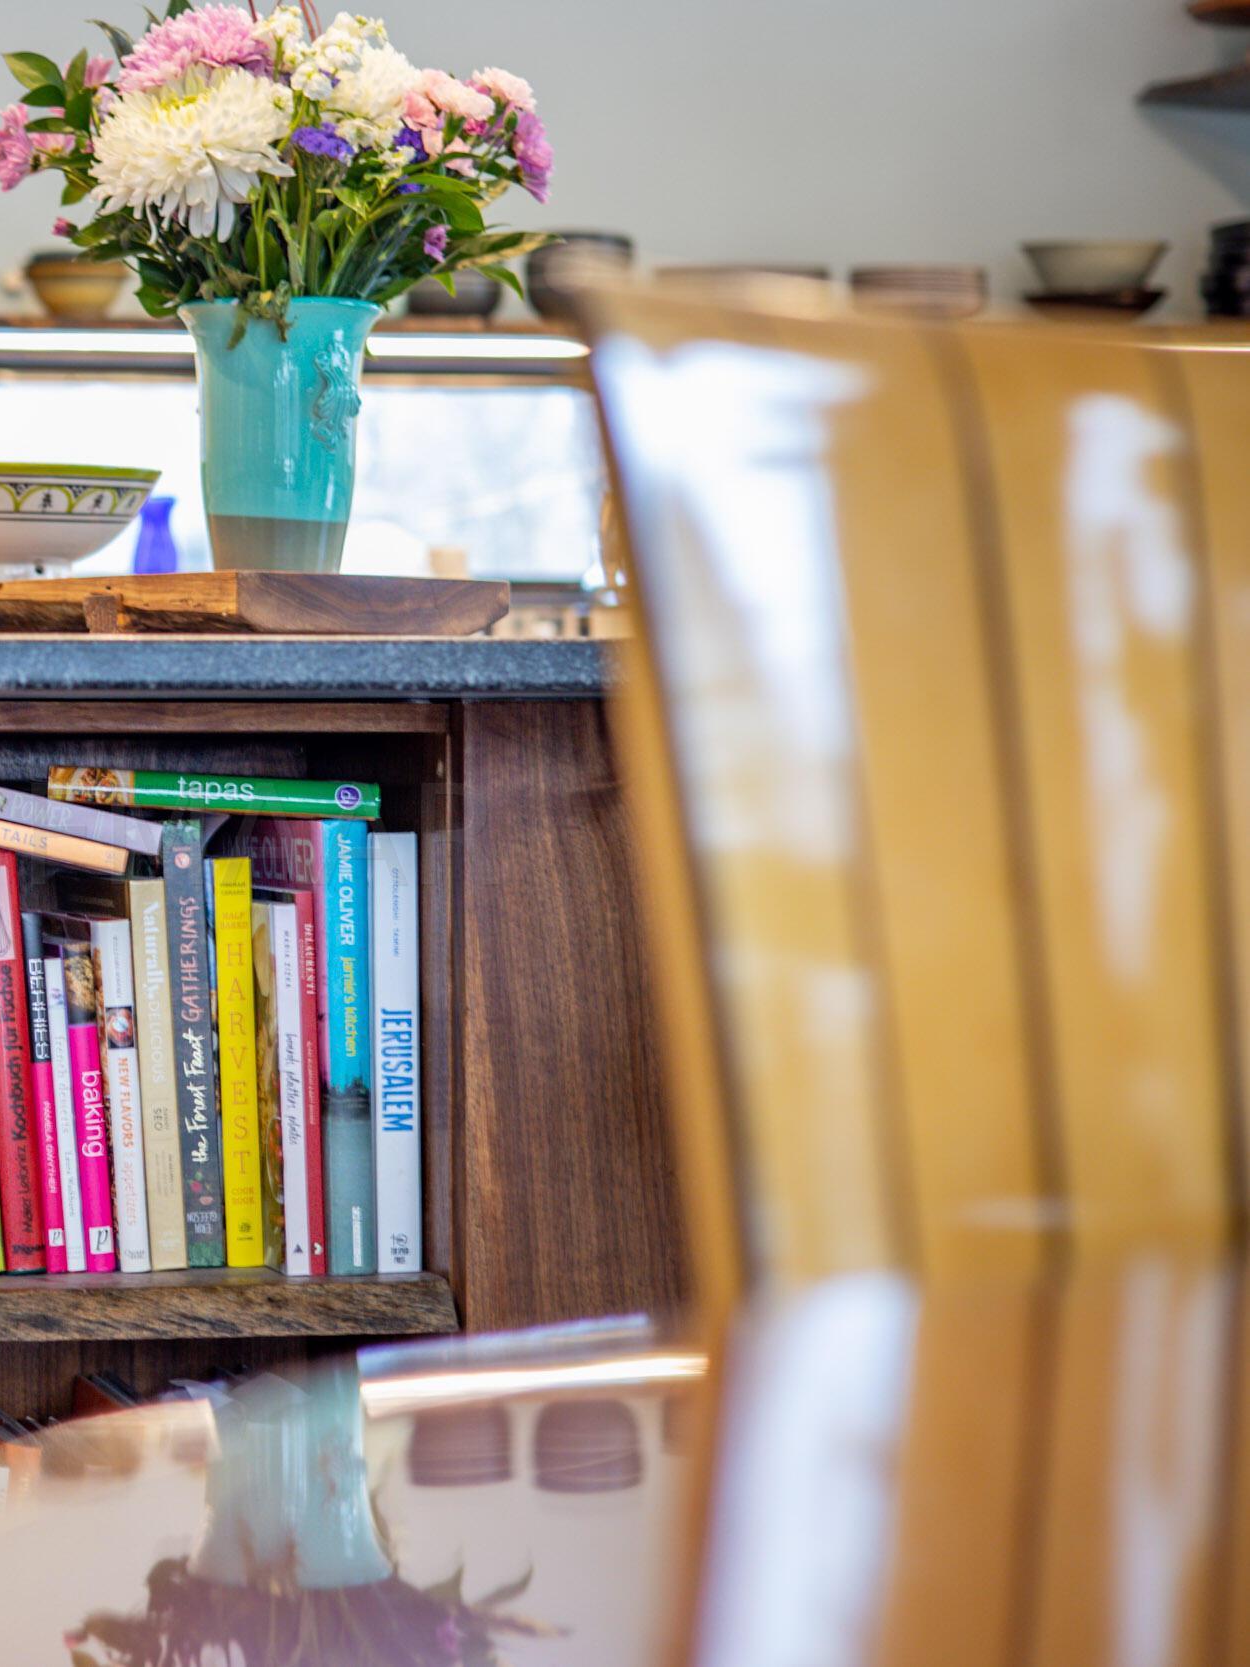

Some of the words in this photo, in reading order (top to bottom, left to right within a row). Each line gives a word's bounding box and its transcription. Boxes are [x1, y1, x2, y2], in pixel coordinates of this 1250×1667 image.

[177, 776, 255, 805] tapas
[337, 833, 352, 883] JAMIE
[339, 886, 355, 945] OLIVER
[180, 896, 205, 1022] GATHERINGS
[28, 959, 50, 1061] BERRIES
[345, 1007, 358, 1057] kitchen
[118, 1057, 131, 1087] NEW
[182, 1027, 207, 1077] Feast
[227, 943, 252, 1175] HARVEST
[381, 1008, 414, 1132] JERUSALEM
[9, 1056, 30, 1141] Kochbuch
[81, 1070, 105, 1158] baking
[120, 1092, 135, 1148] FLAVORS
[184, 1083, 209, 1132] Forest
[191, 1134, 209, 1163] the
